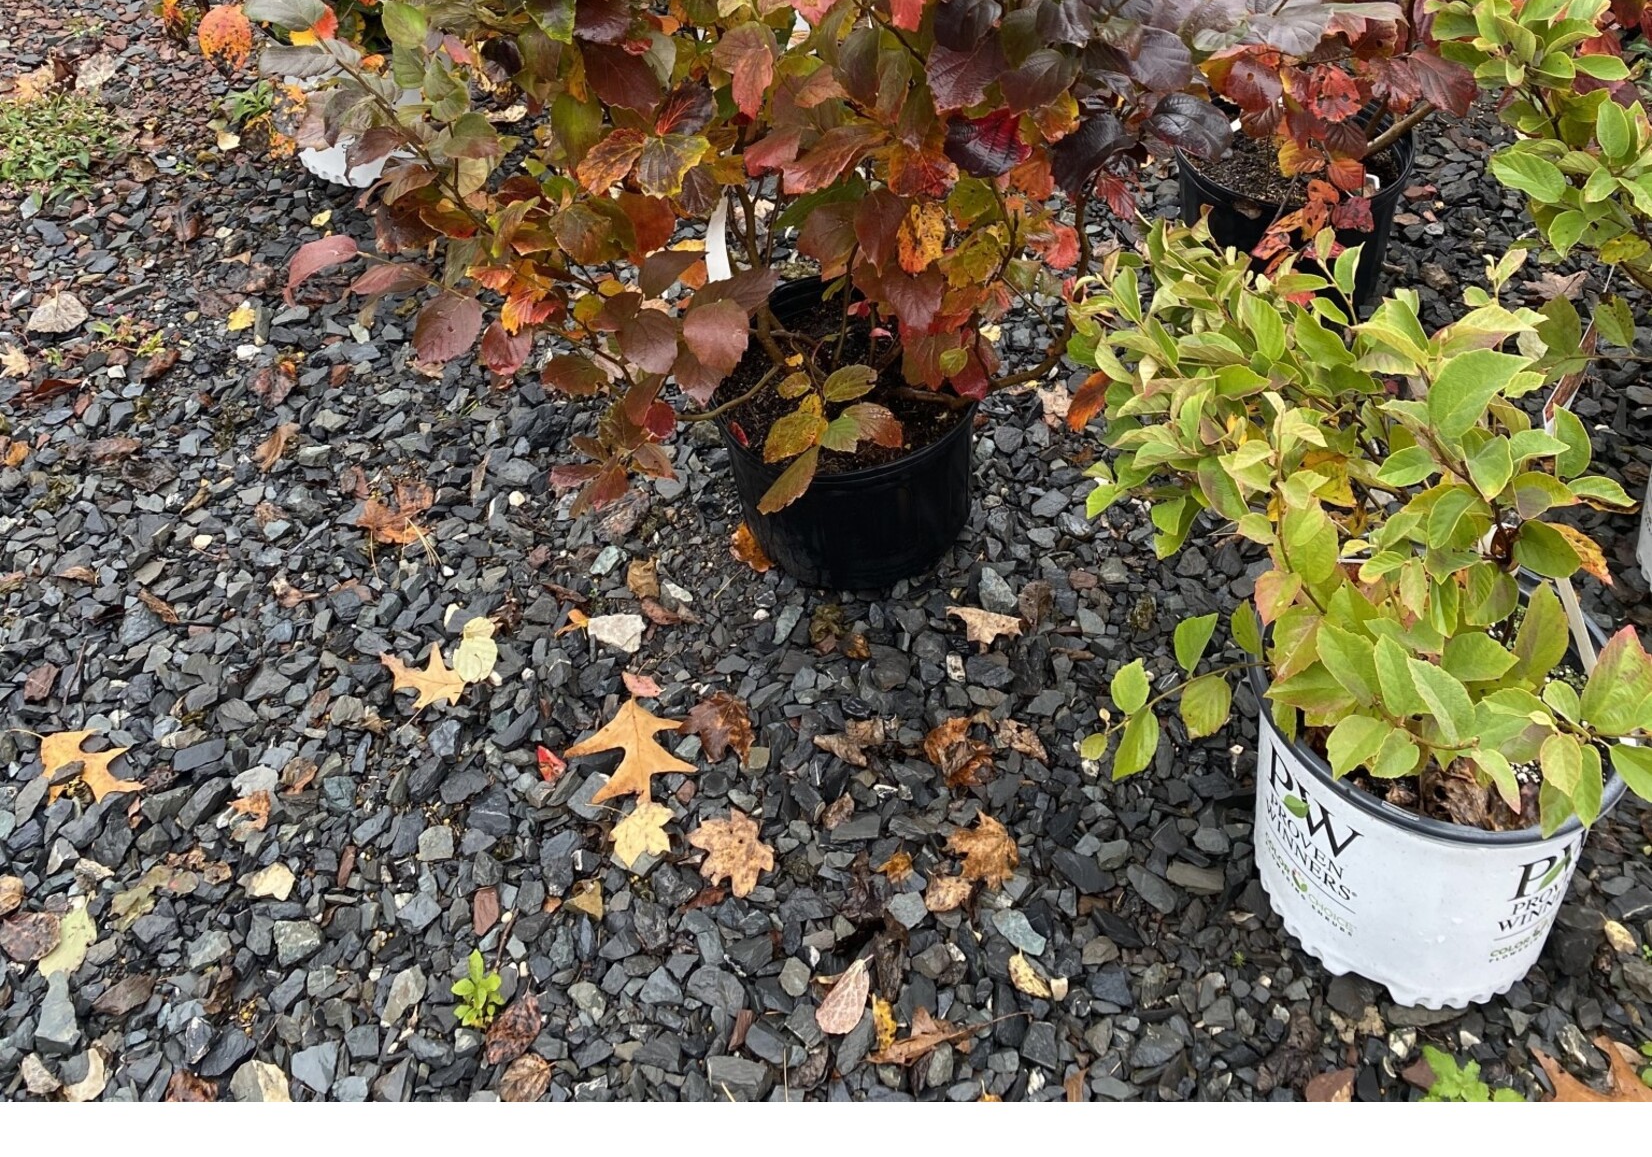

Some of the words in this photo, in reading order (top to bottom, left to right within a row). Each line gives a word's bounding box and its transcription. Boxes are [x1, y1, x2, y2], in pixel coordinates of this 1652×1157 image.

[1268, 738, 1364, 858] PW
[1270, 792, 1345, 880] PROVEN
[1308, 892, 1354, 931] CHOICE
